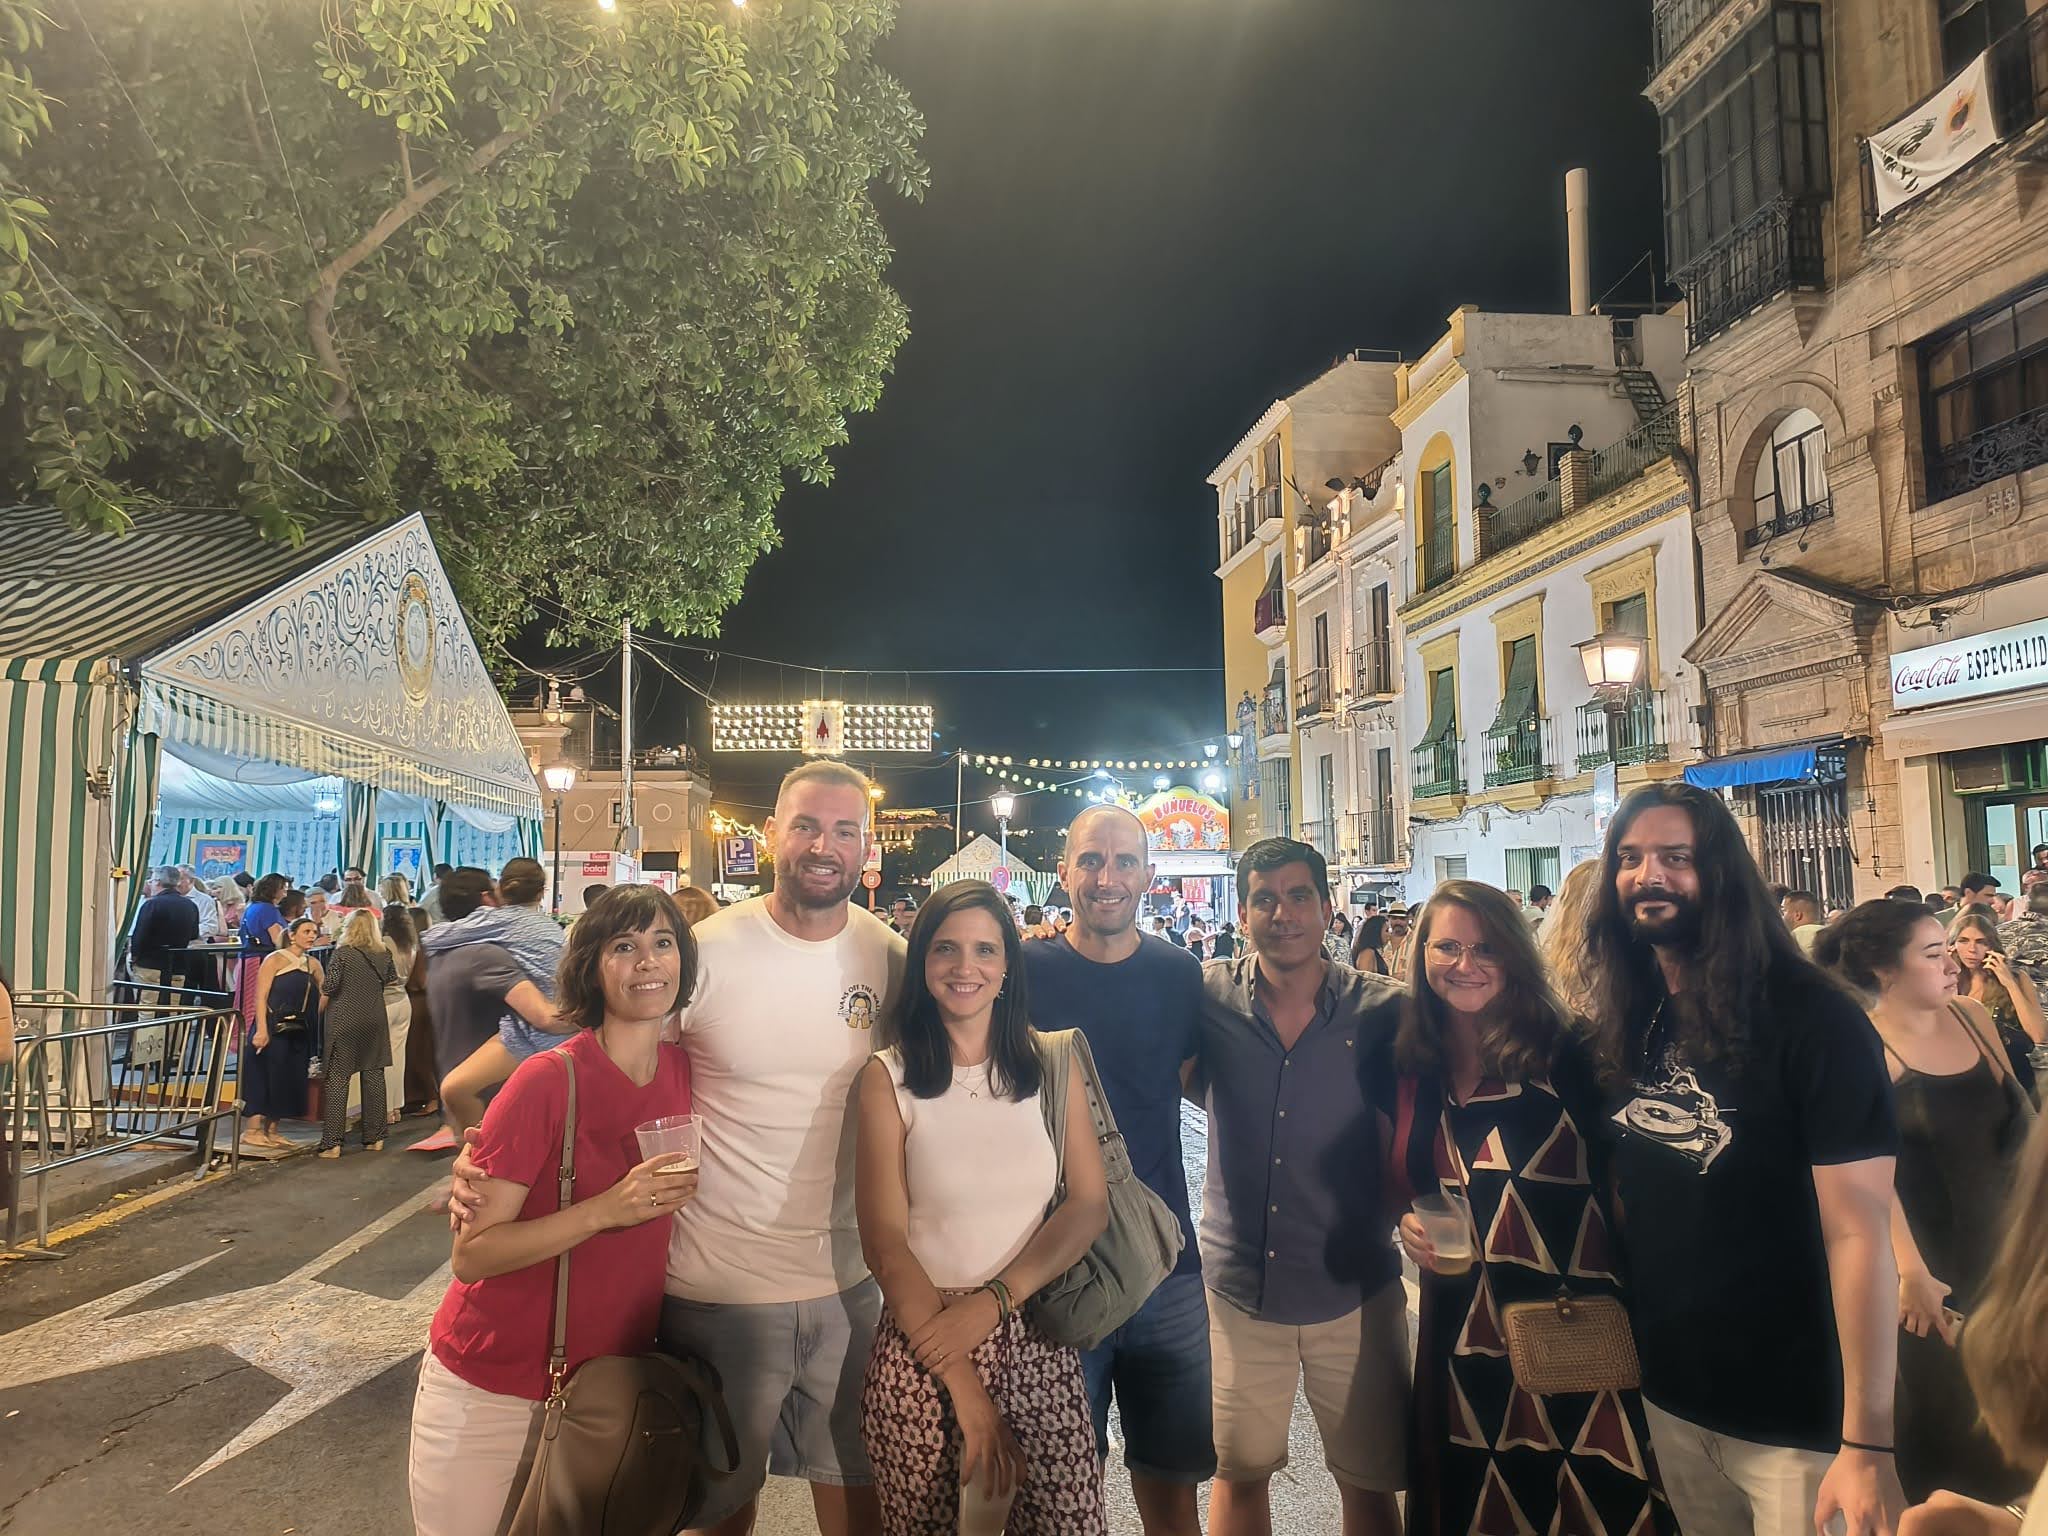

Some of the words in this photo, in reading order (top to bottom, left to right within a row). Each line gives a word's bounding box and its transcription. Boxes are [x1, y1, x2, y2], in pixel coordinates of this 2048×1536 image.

[1966, 635, 2048, 681] ESPECIALID
[1153, 797, 1216, 820] BUÑUELOS
[729, 839, 745, 859] P
